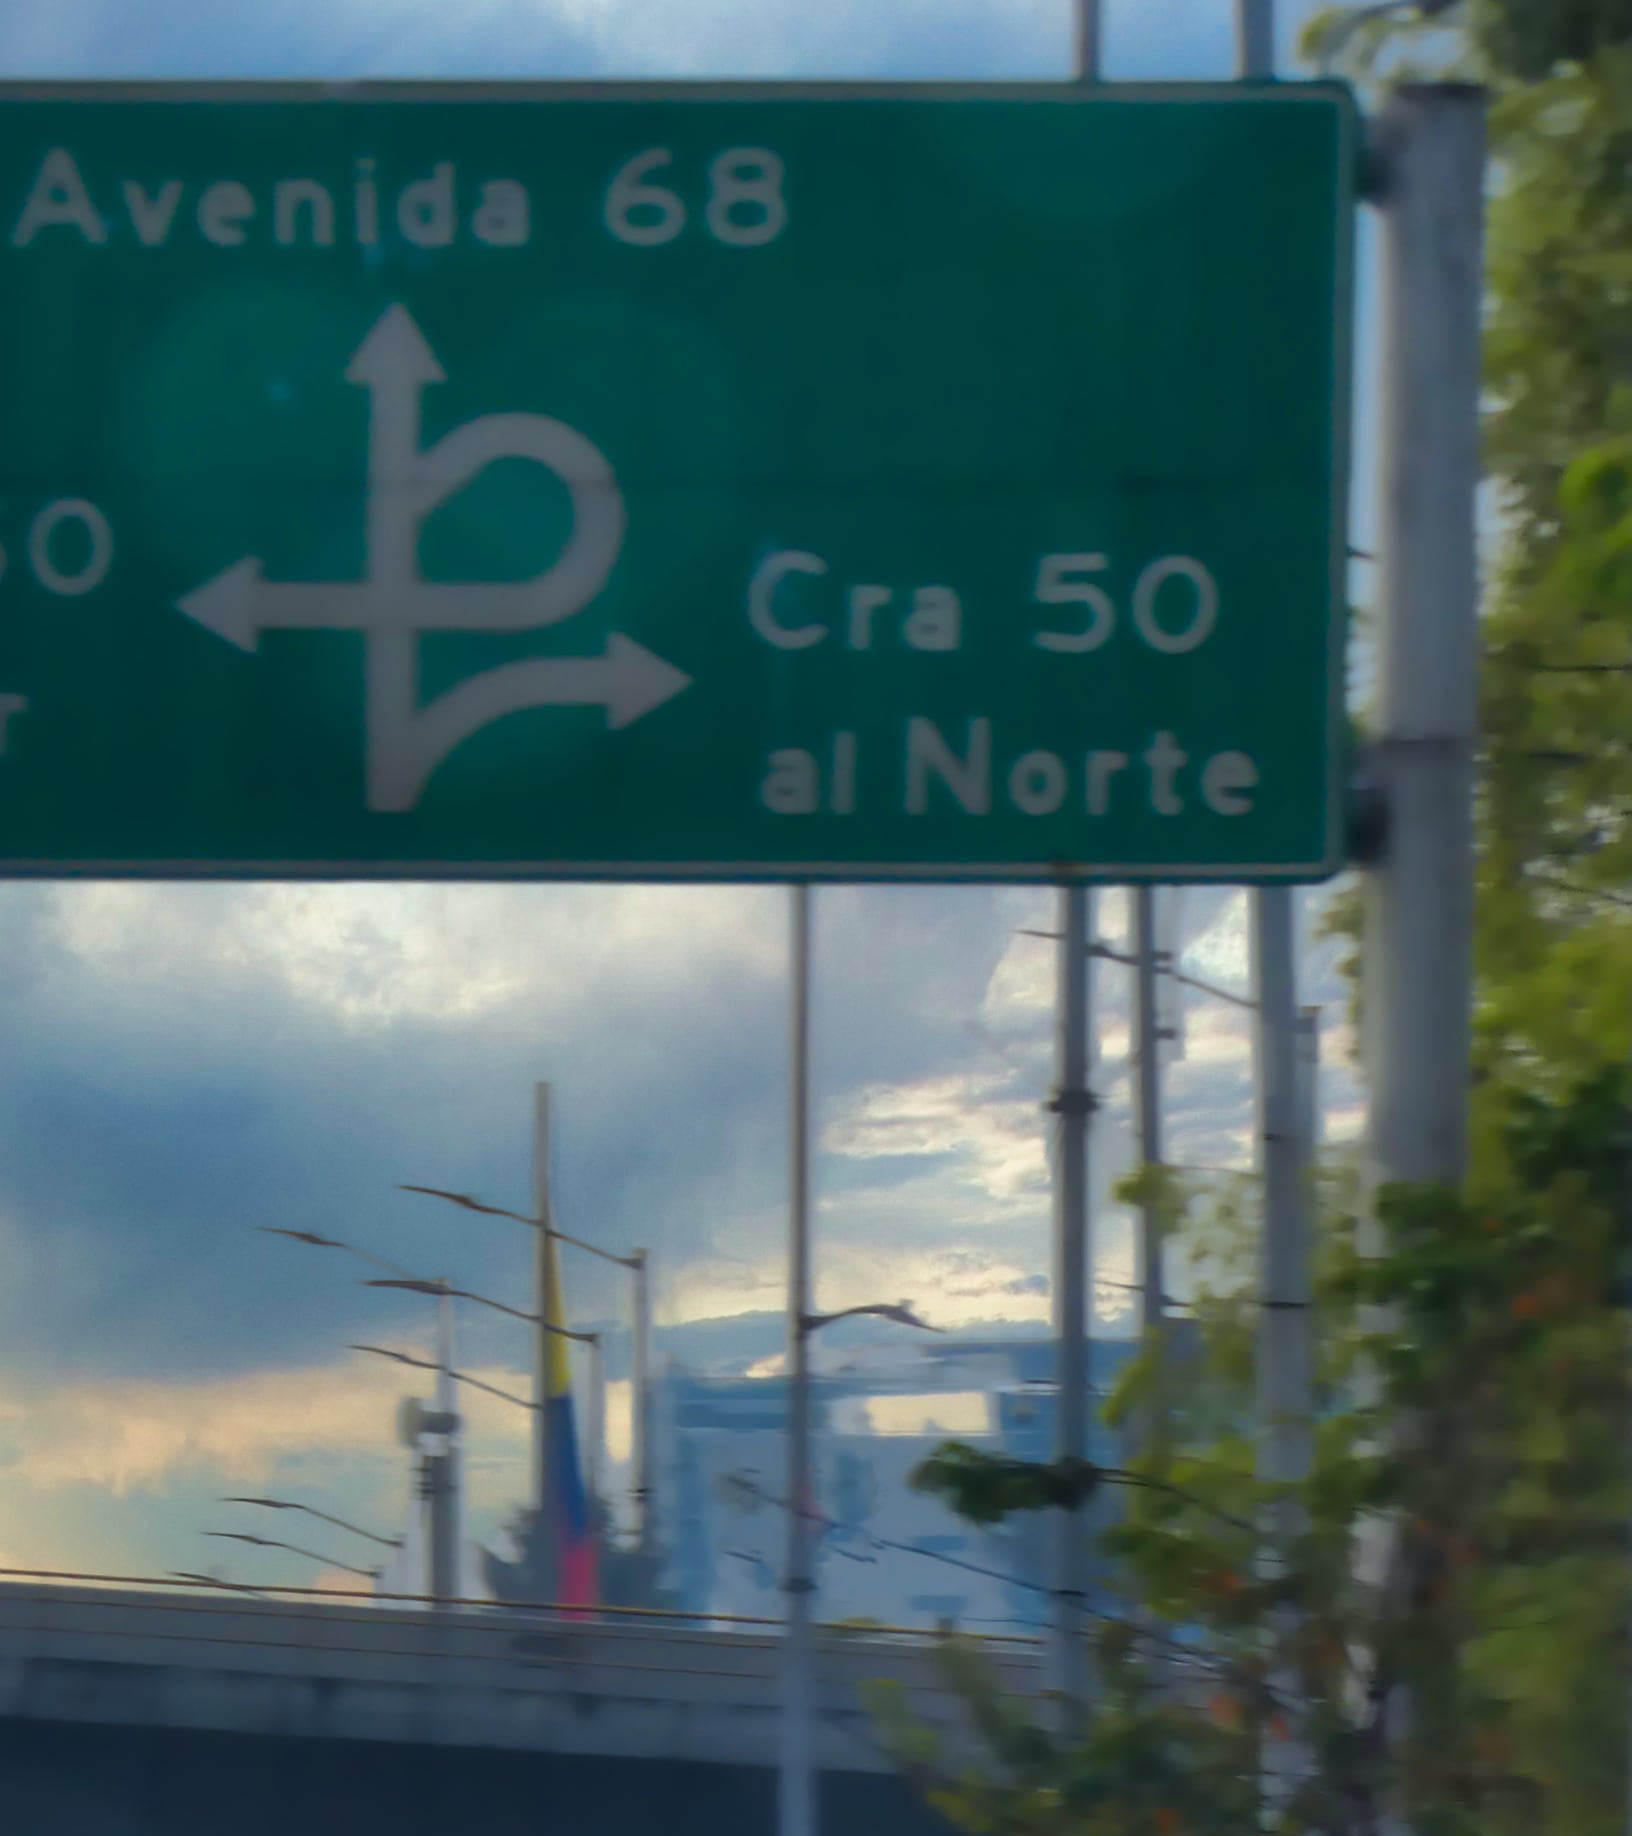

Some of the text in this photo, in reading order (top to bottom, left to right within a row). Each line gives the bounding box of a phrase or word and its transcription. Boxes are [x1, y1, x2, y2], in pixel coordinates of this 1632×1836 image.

[12, 145, 790, 249] Avenida 68
[746, 547, 1221, 656] Cra 50
[759, 714, 1262, 818] al Norte
